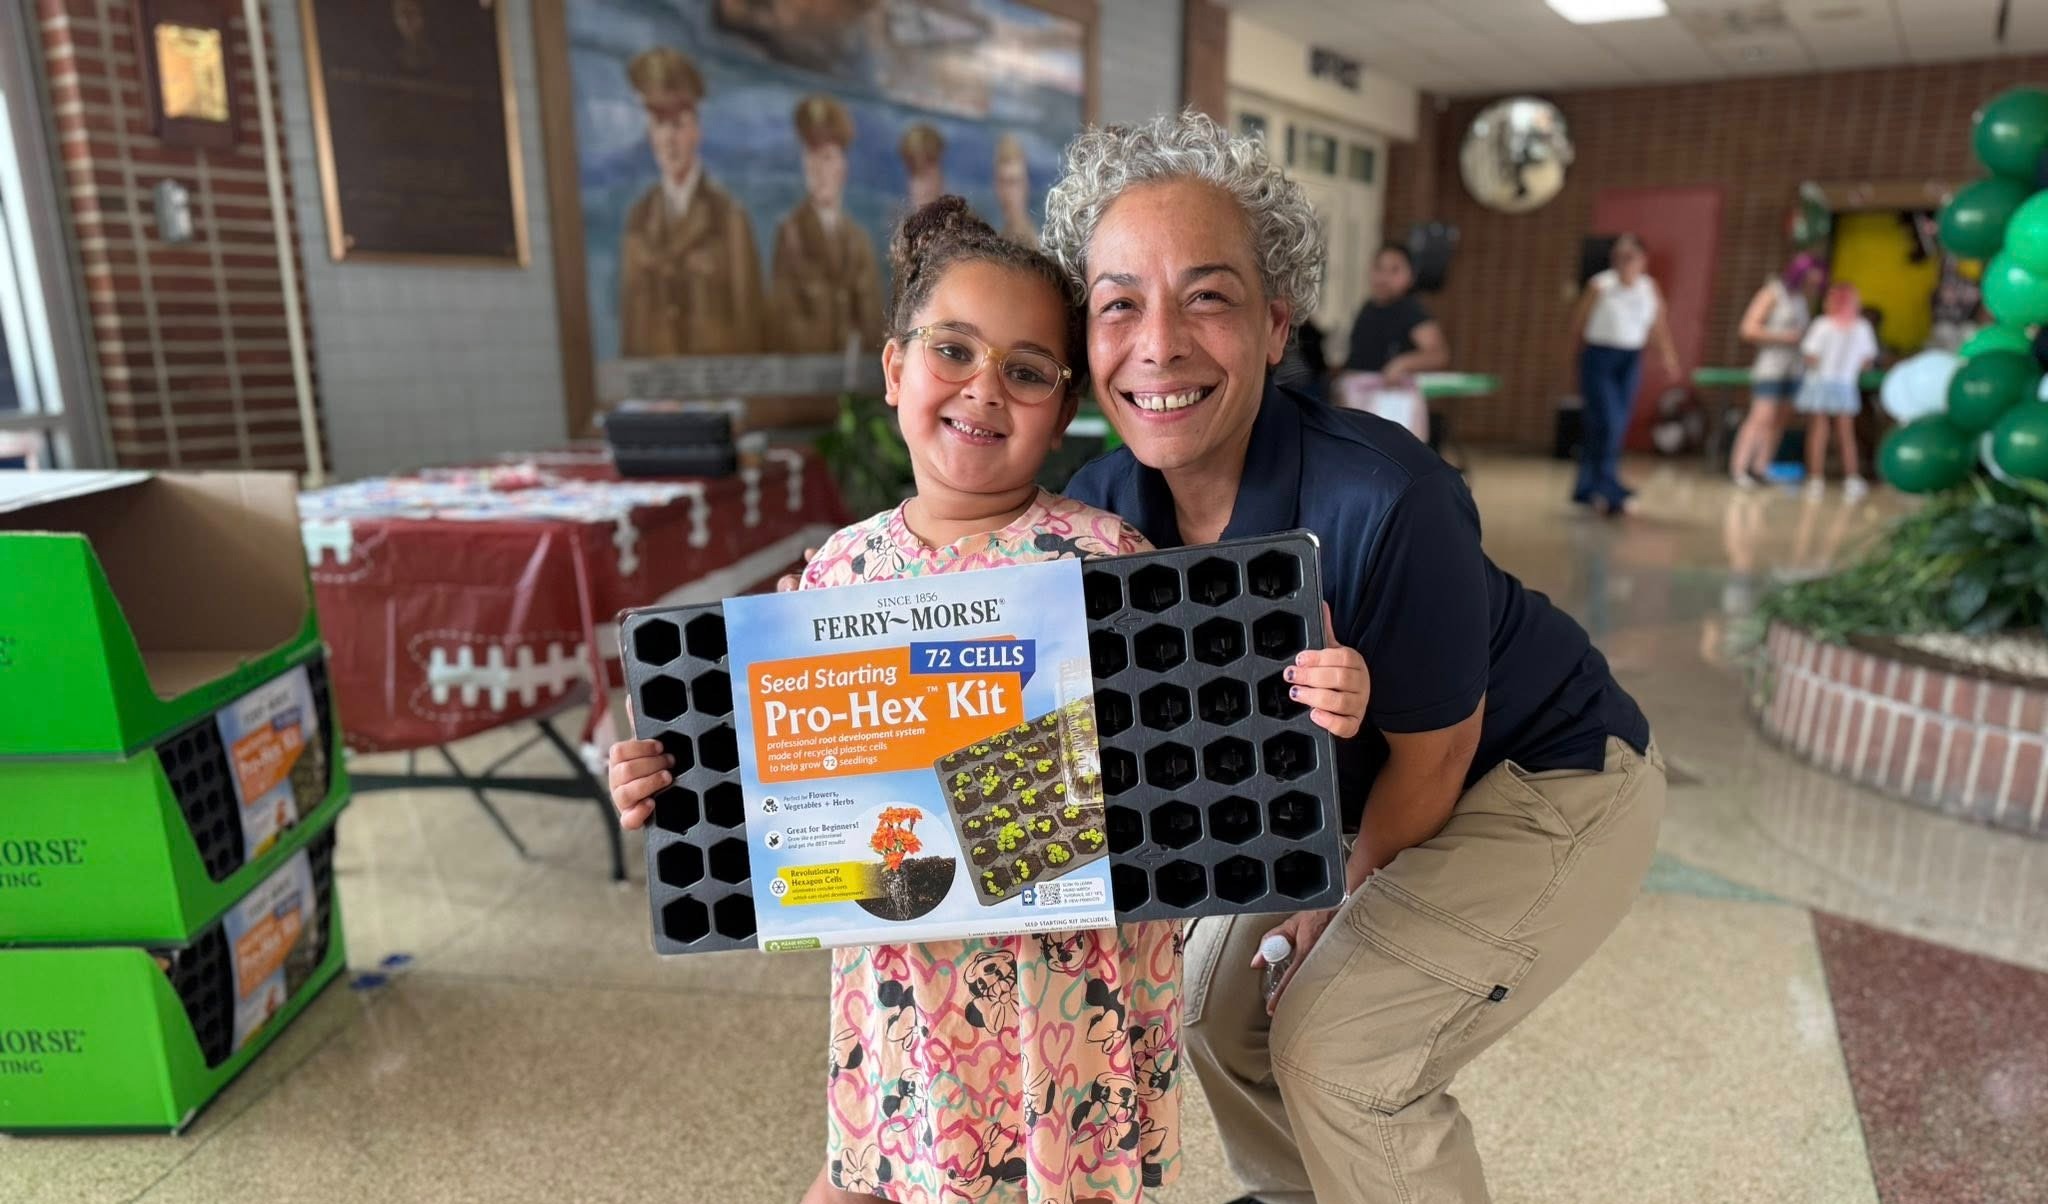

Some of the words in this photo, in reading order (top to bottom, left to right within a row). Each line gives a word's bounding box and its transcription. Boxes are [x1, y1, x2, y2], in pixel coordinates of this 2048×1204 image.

[877, 595, 912, 608] SINCE
[915, 592, 938, 603] 1856
[925, 649, 951, 668] 72
[959, 646, 1024, 667] CELLS
[760, 670, 809, 694] Seed
[815, 664, 897, 689] Starting
[947, 679, 1007, 719] Kit
[767, 738, 818, 751] professional
[838, 731, 894, 743] development
[895, 728, 925, 738] system
[768, 752, 792, 761] made
[793, 750, 802, 760] of
[803, 747, 838, 760] recycled
[840, 744, 867, 756] plastic
[869, 742, 888, 751] cells
[770, 764, 779, 773] to
[780, 762, 798, 774] help
[800, 762, 821, 773] grow
[824, 759, 836, 767] 72
[839, 755, 878, 767] seedlings
[784, 801, 822, 811] Vegetables
[833, 798, 854, 806] Herbs
[787, 827, 807, 835] Great
[821, 821, 859, 832] Beginners!
[0, 838, 83, 866] ORSE
[790, 868, 840, 878] Revolutionary
[791, 879, 823, 887] Hexagon
[825, 875, 842, 883] Cells
[0, 1029, 82, 1054] ORSE
